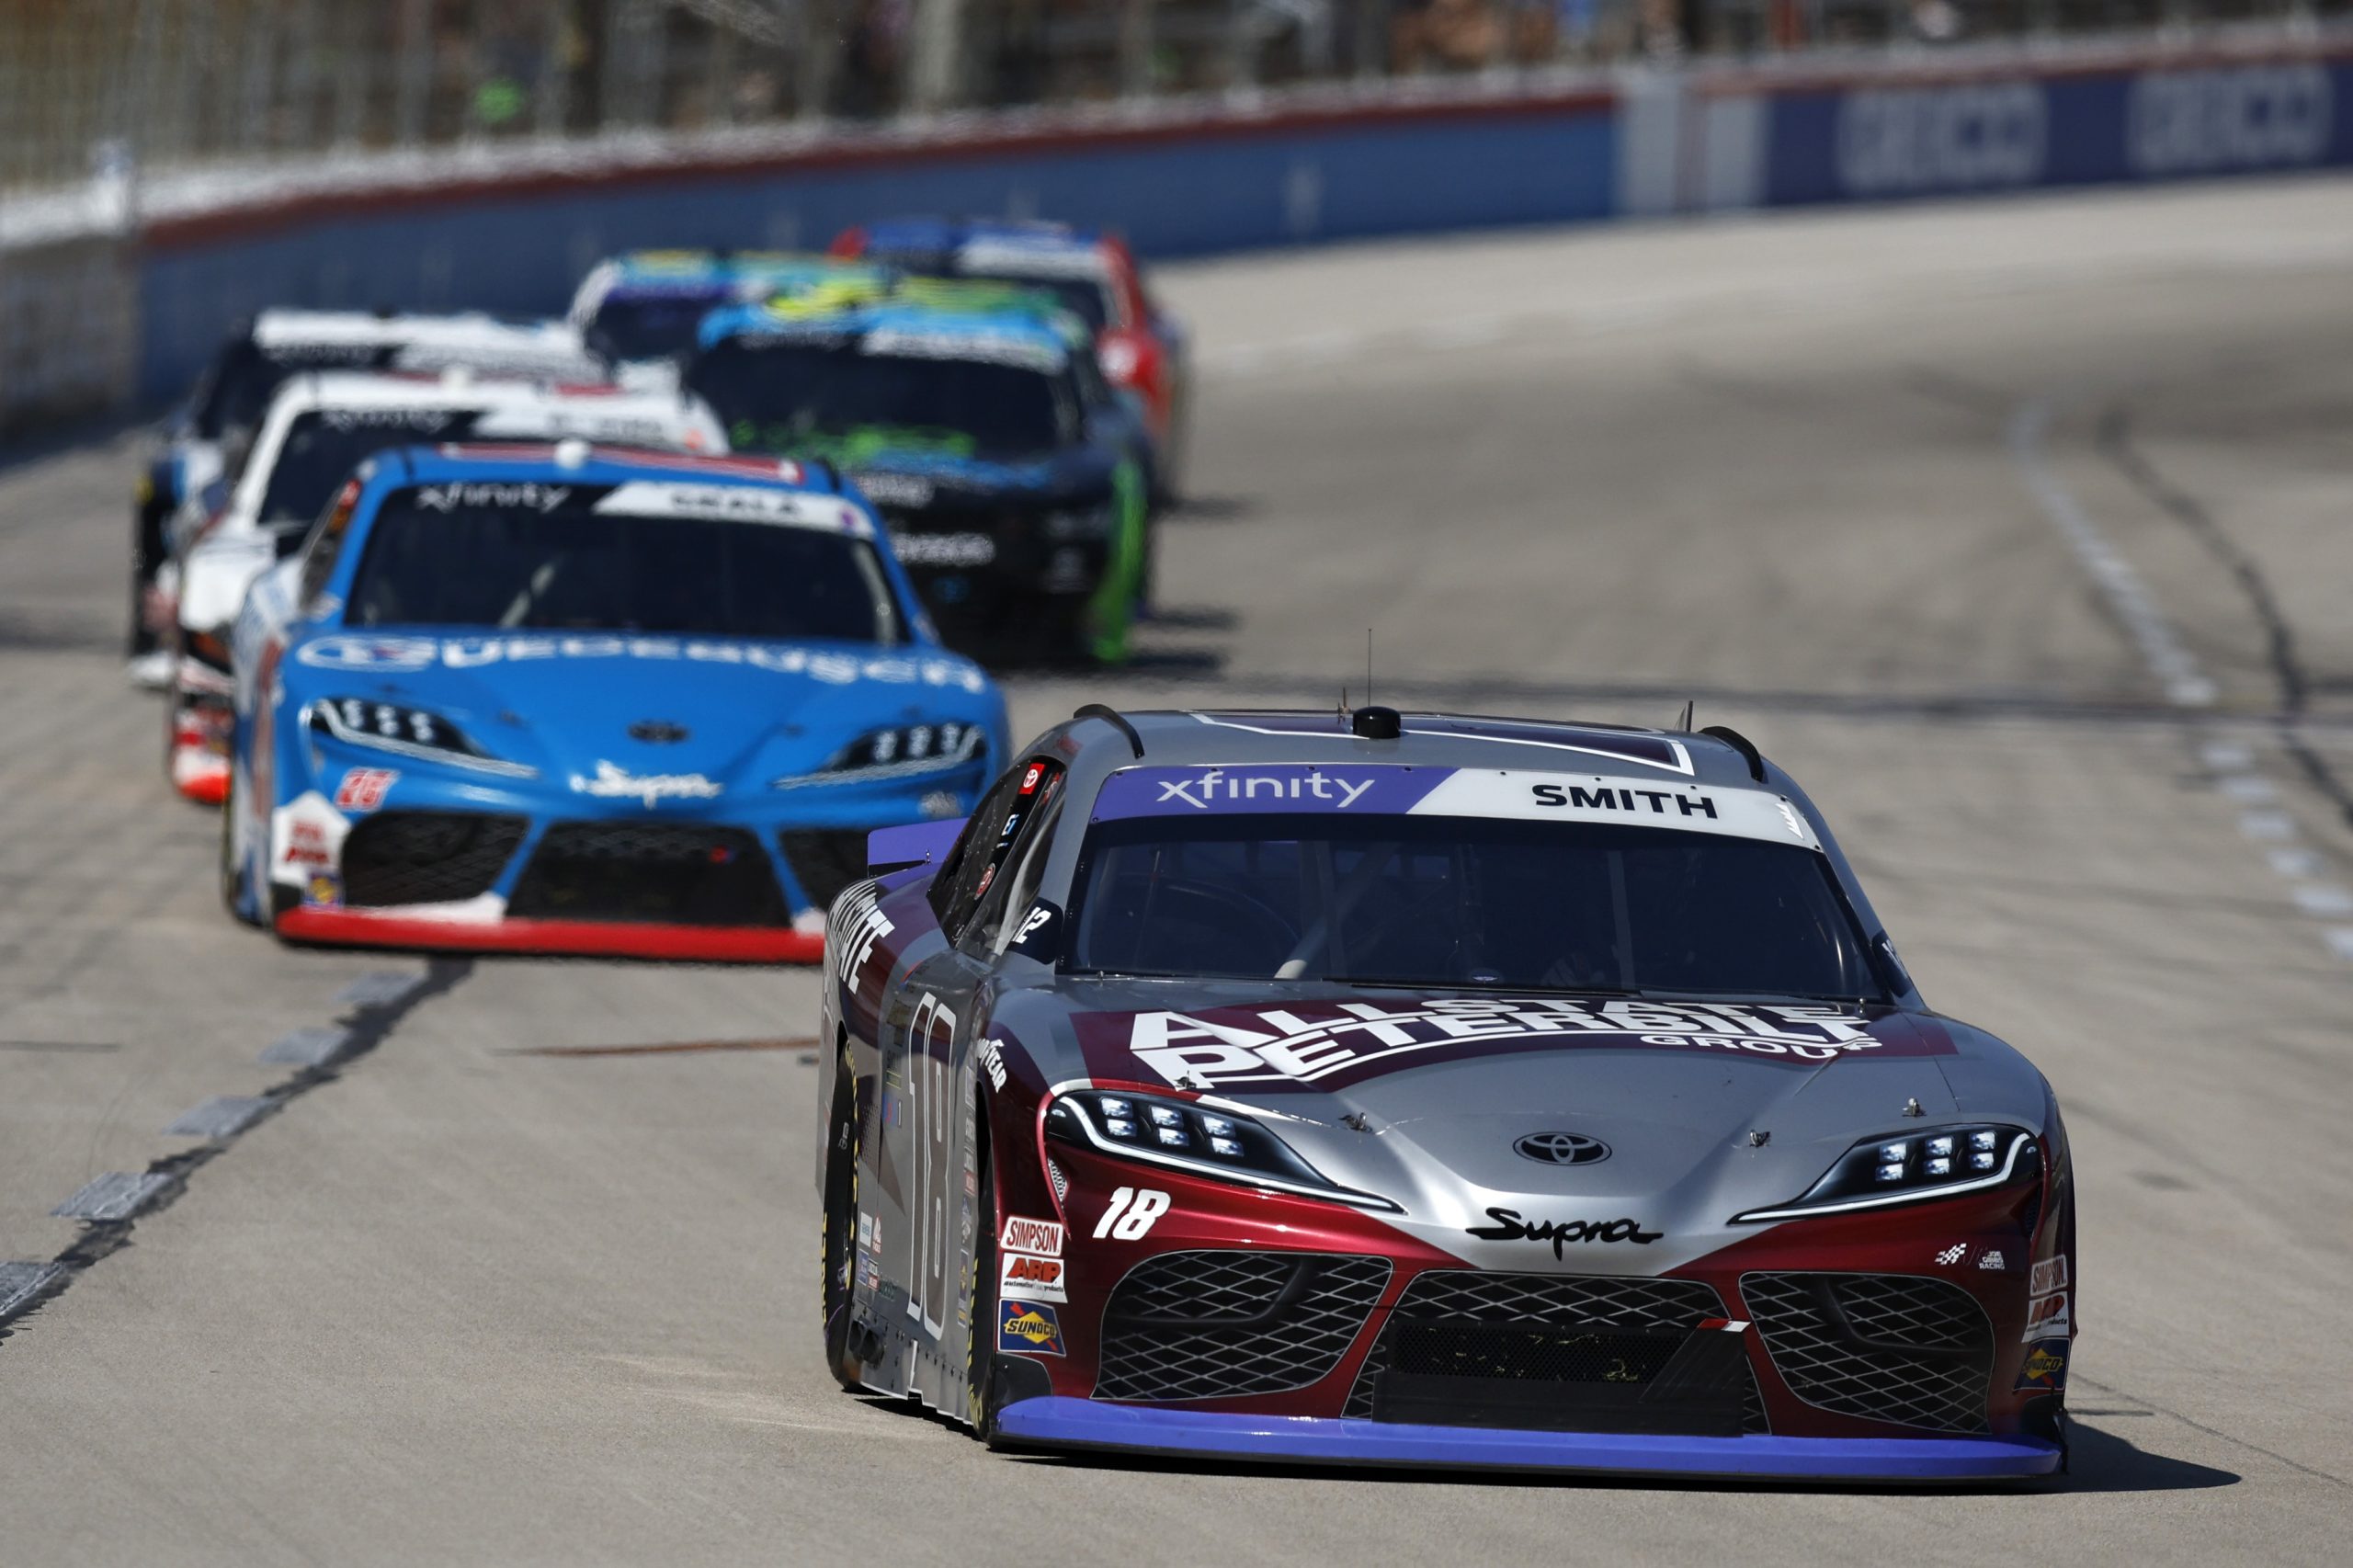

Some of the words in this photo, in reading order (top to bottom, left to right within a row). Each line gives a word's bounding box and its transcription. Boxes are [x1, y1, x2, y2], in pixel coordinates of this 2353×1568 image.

[1157, 771, 1374, 809] xfinity
[1533, 784, 1718, 819] SMITH
[1130, 999, 1861, 1050] ALLSTATE
[1131, 1013, 1871, 1092] PETERBILT
[1641, 1035, 1882, 1059] GROUP
[907, 992, 956, 1341] 18
[1092, 1187, 1171, 1241] 18
[1006, 1220, 1060, 1253] SIMPSON
[1465, 1207, 1665, 1262] Supra
[1006, 1257, 1062, 1283] ARP
[1979, 1262, 2005, 1270] RACING
[2032, 1257, 2066, 1292] SIMPSON
[1007, 1320, 1056, 1337] SUNOCO
